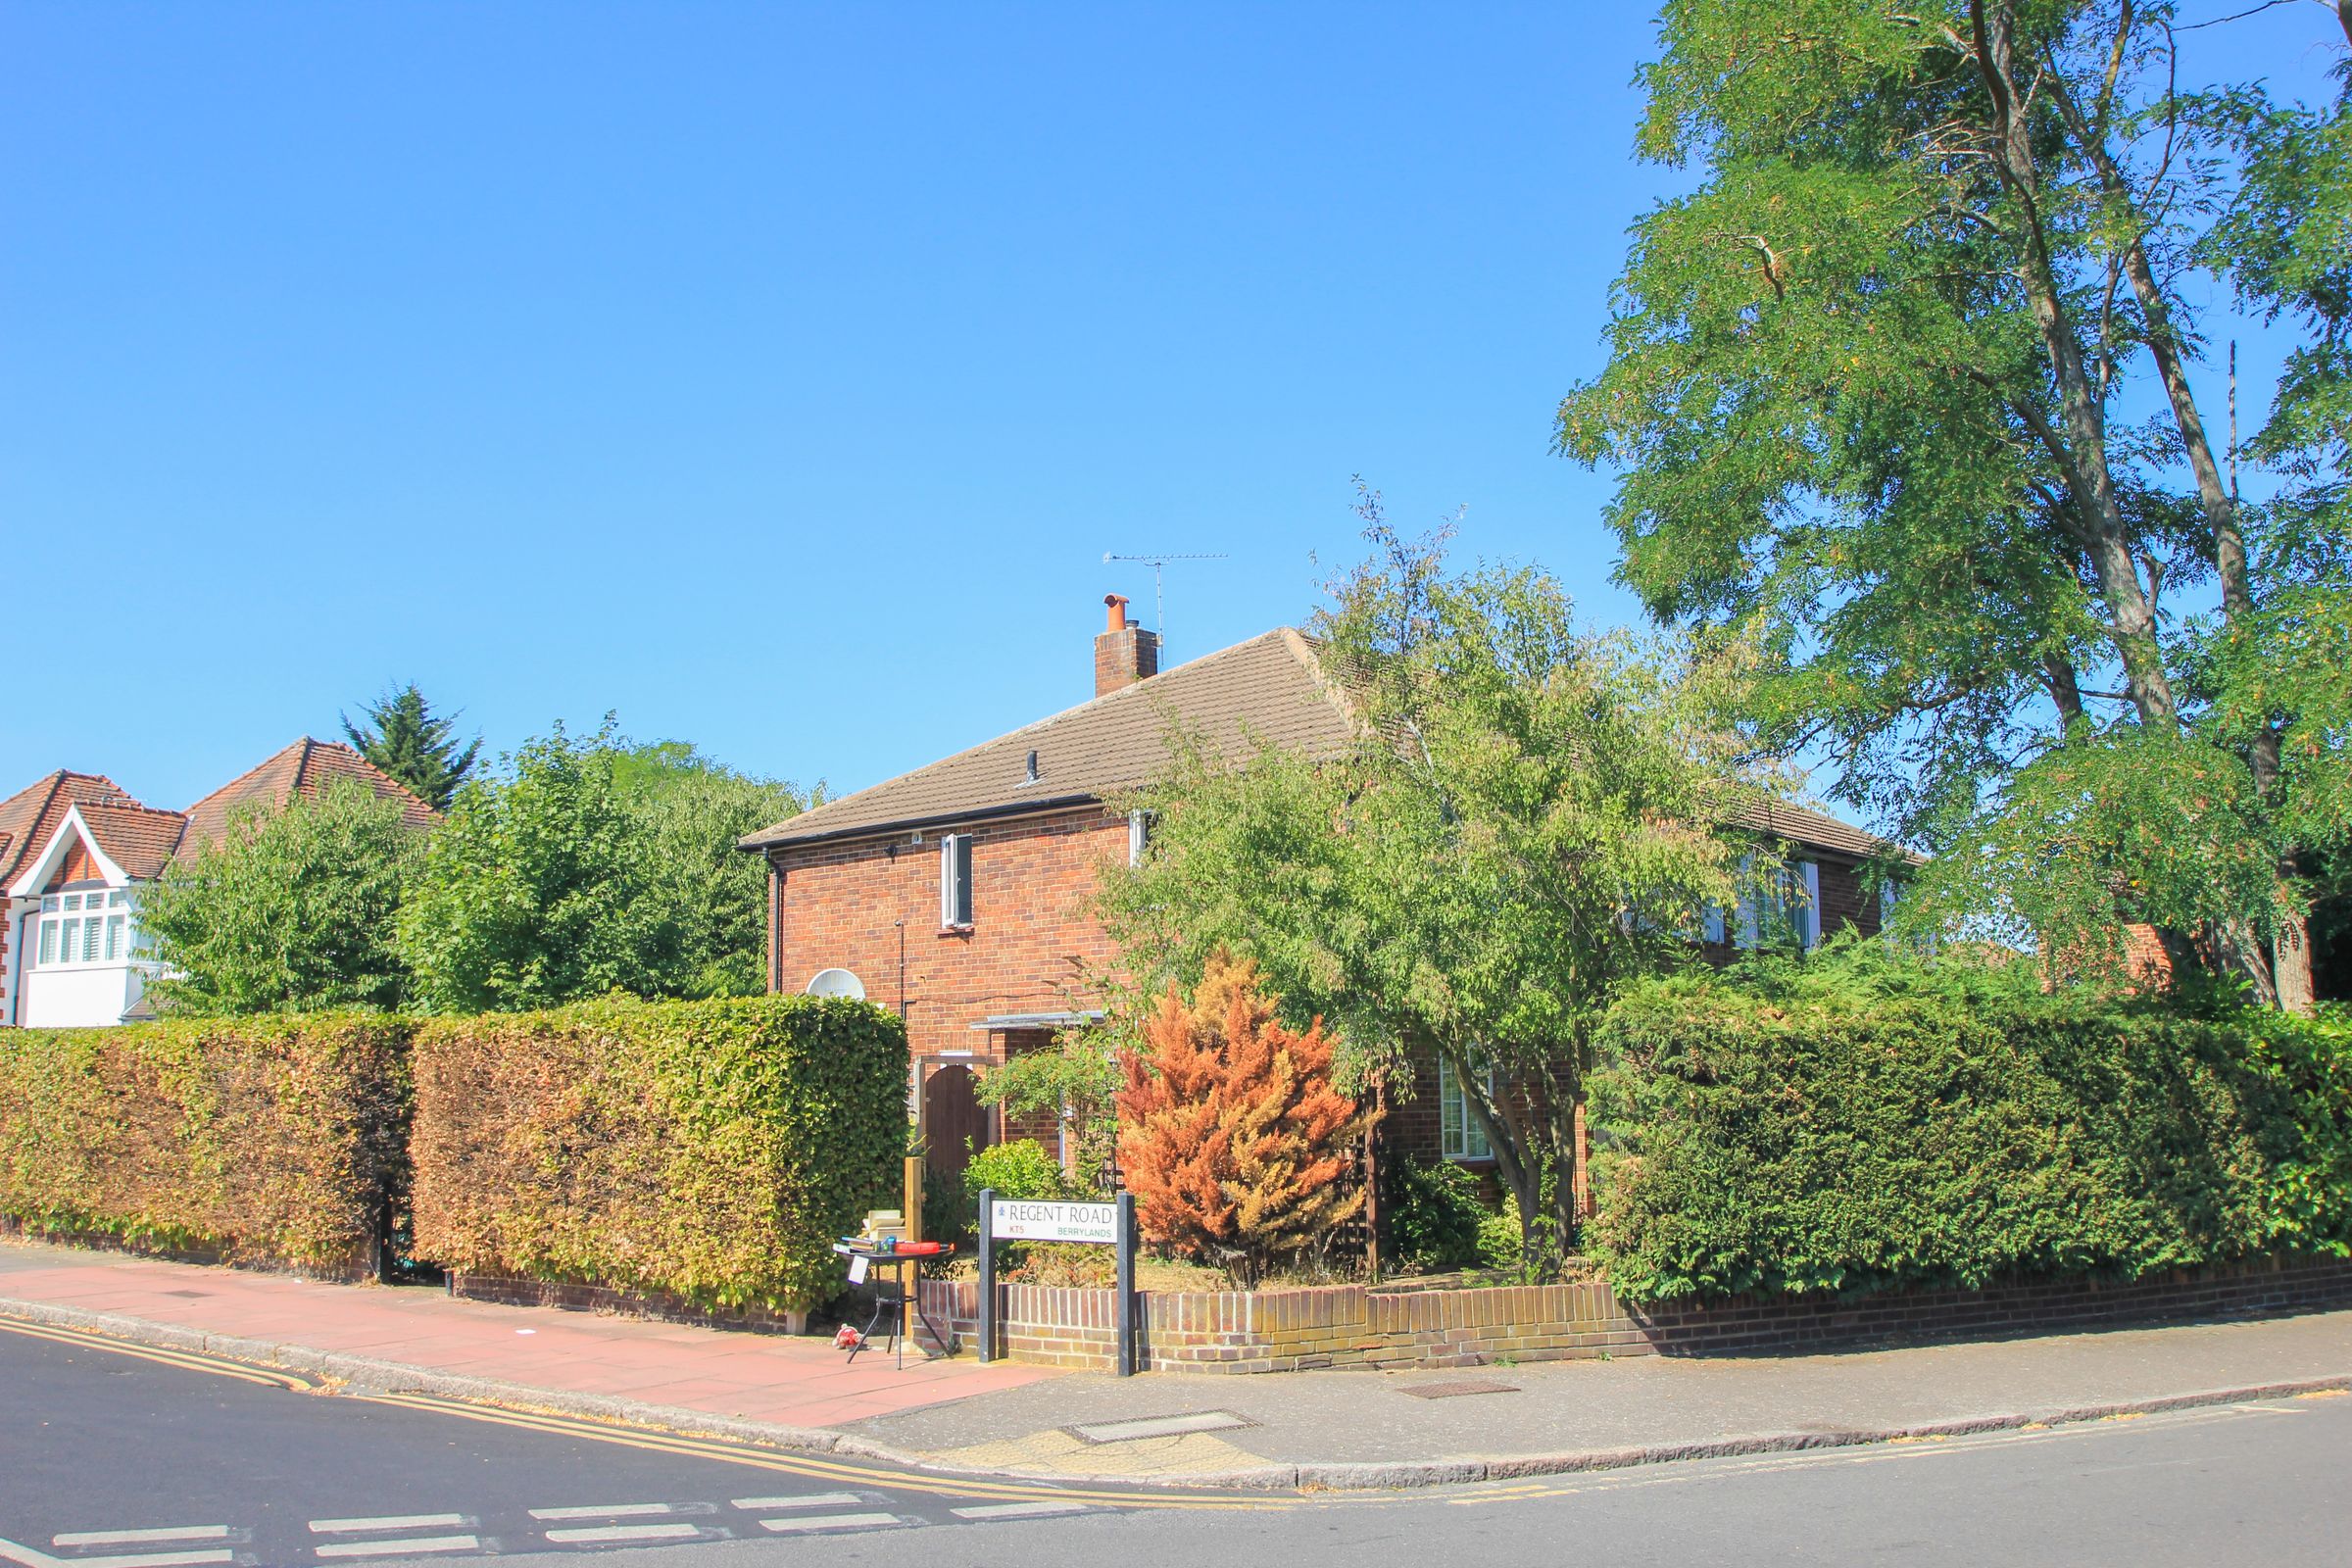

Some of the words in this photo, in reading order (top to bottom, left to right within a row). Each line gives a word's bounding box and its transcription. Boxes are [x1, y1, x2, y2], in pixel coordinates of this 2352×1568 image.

[1009, 1204, 1063, 1222] REGENT
[1069, 1206, 1112, 1224] ROAD
[1009, 1225, 1025, 1234] KT5
[1057, 1227, 1112, 1238] BERRYLANDS
